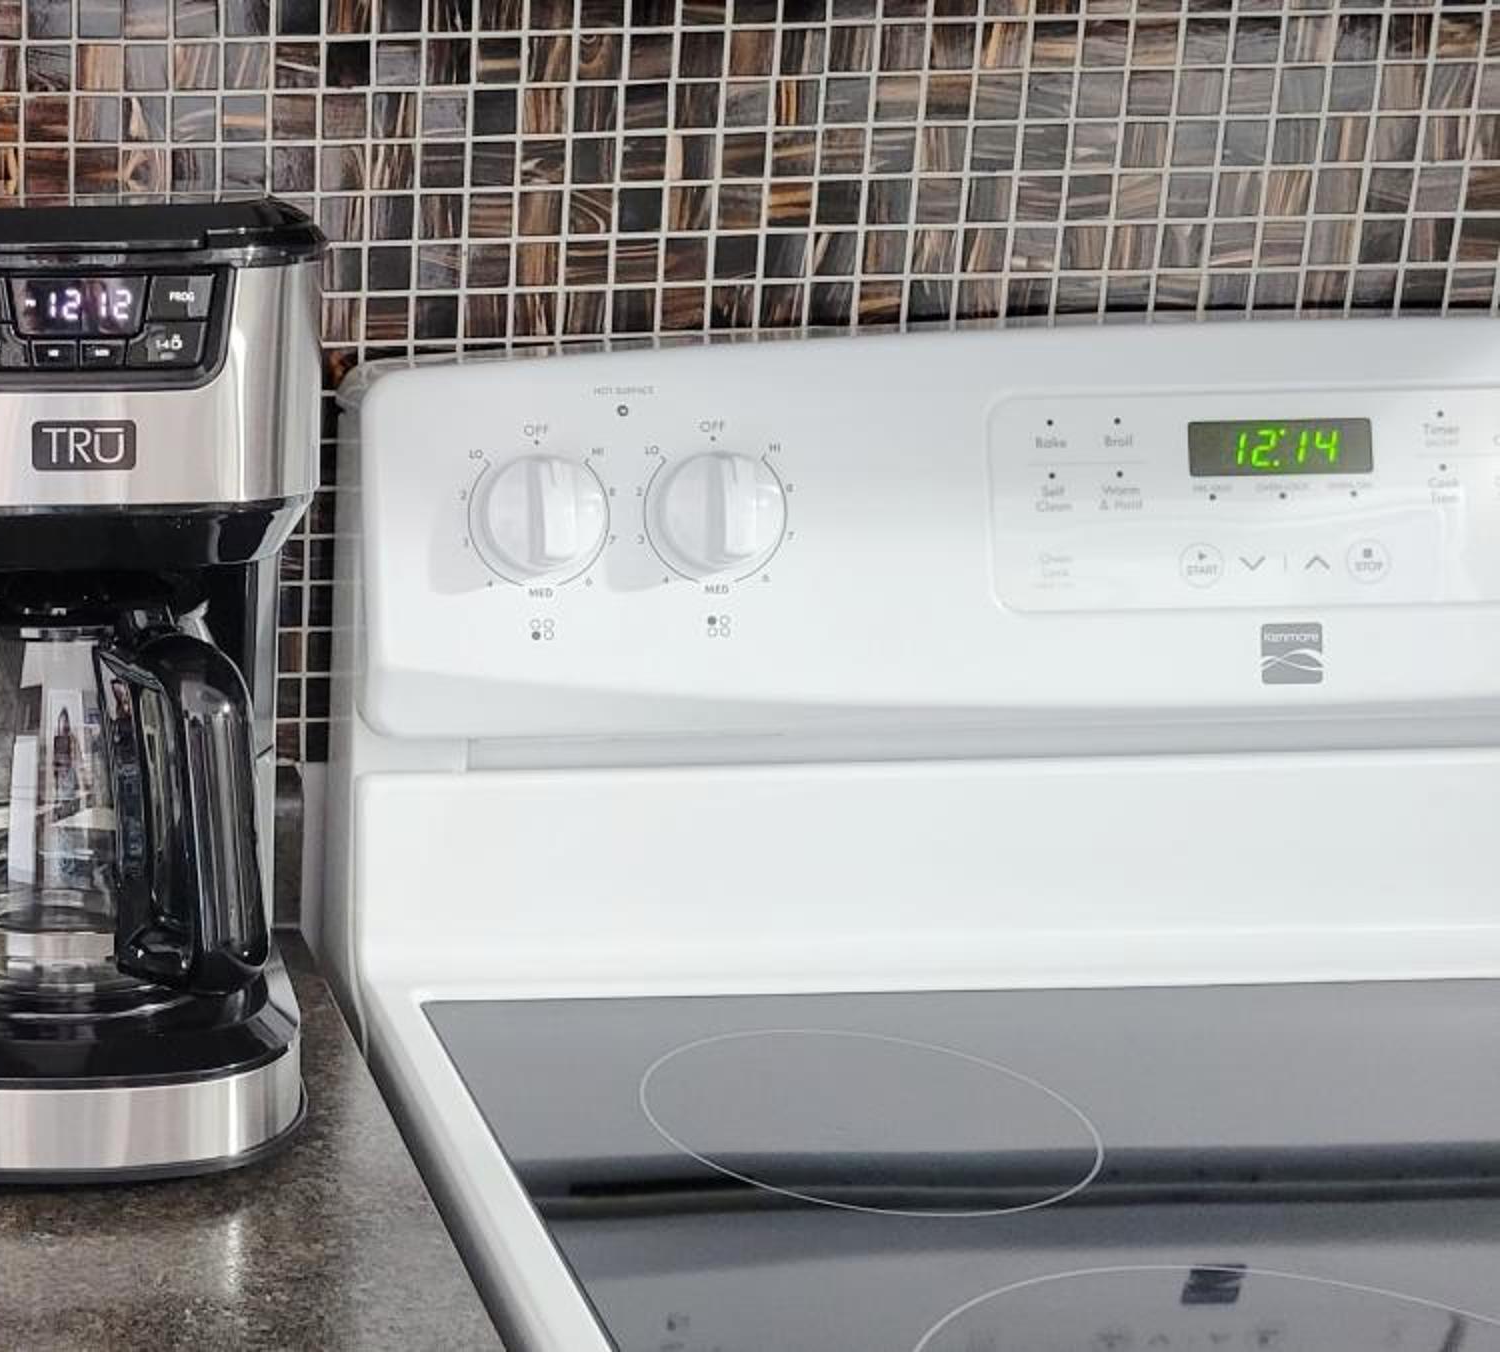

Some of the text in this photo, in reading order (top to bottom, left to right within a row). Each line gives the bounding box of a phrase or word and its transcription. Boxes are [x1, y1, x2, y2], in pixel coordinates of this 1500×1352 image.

[169, 291, 195, 302] PROG
[523, 424, 548, 437] OFF
[699, 420, 724, 433] OFF
[1035, 436, 1067, 449] Bake
[1104, 434, 1133, 448] Broil
[591, 447, 605, 456] HI
[644, 445, 660, 456] LO
[769, 443, 781, 453] HI
[1236, 428, 1339, 468] 12:14
[468, 449, 484, 460] LO
[1187, 564, 1218, 576] START
[1355, 561, 1384, 572] STOP
[528, 588, 554, 599] MED
[704, 584, 730, 595] MED
